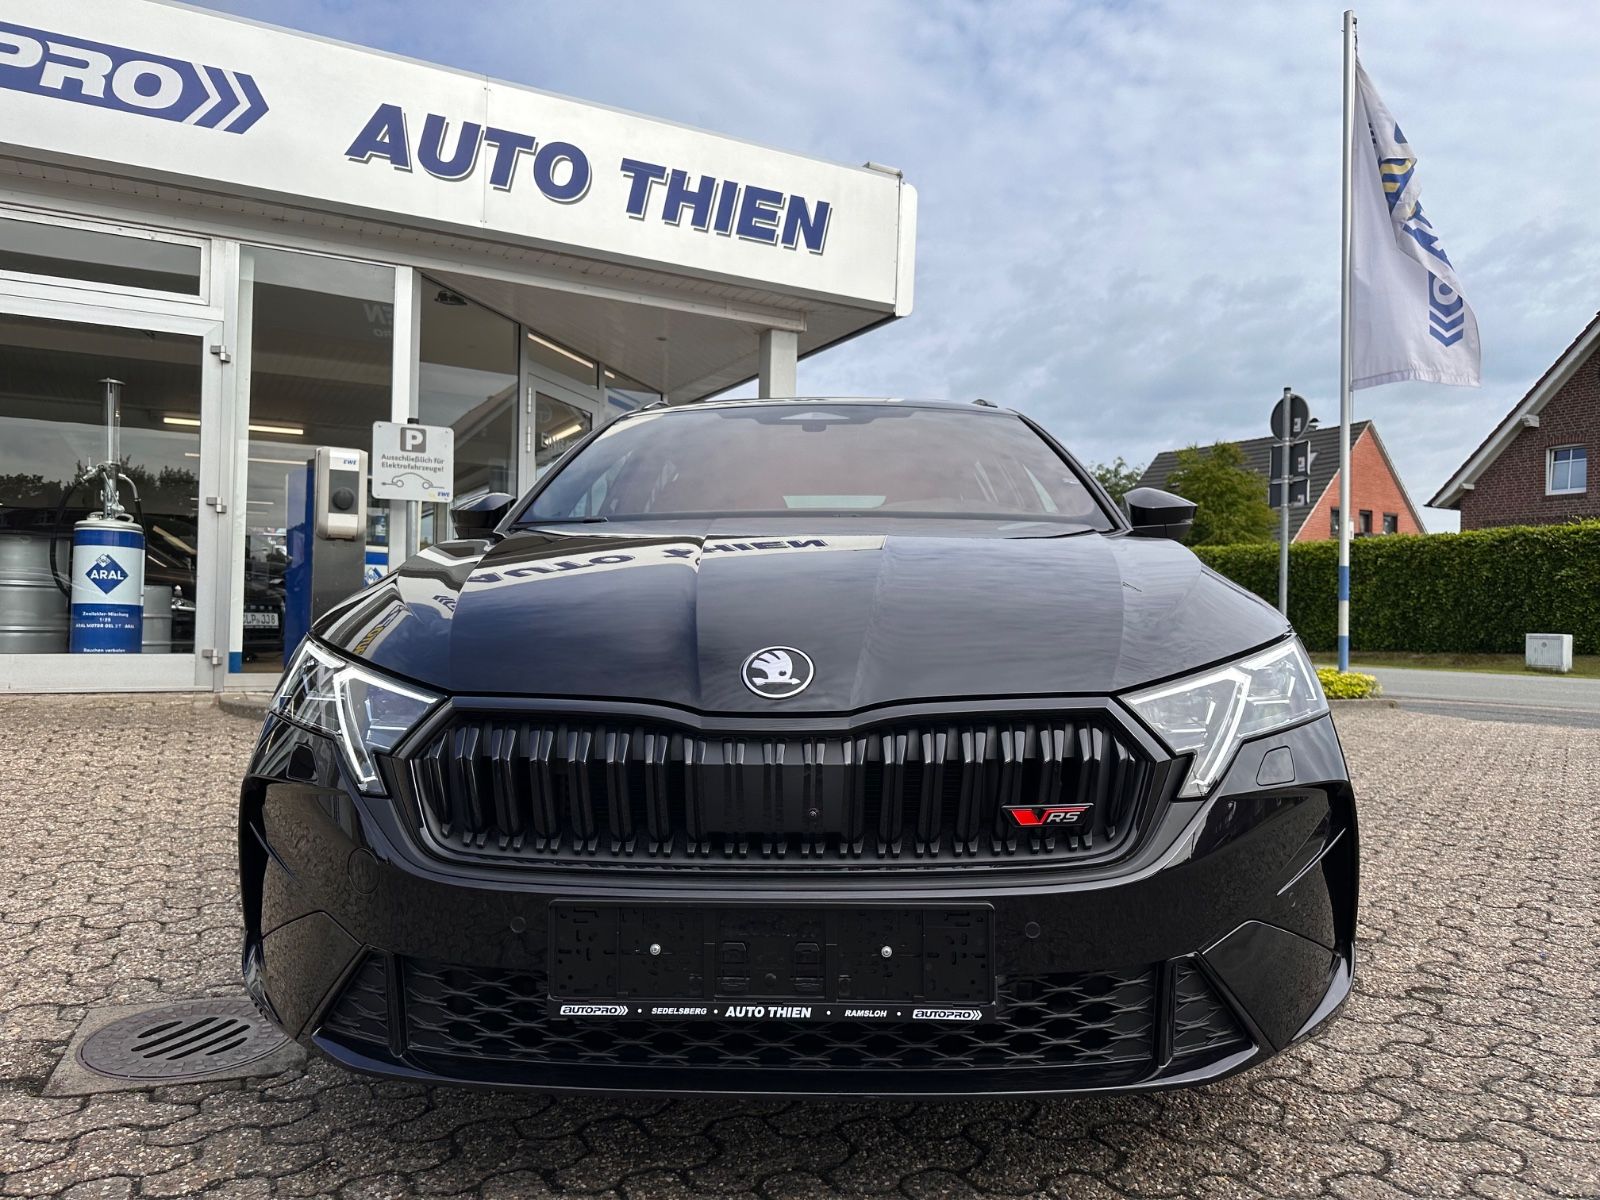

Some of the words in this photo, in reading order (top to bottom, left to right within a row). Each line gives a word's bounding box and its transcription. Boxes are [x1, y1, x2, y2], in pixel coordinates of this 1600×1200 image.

[344, 103, 591, 203] AUTO
[619, 157, 832, 255] THIEN
[405, 429, 424, 451] P
[381, 454, 433, 464] Ausschließlich
[433, 457, 445, 465] für
[90, 569, 125, 580] ARAL
[651, 1007, 708, 1015] SEDELSBERG
[725, 1006, 764, 1018] AUTO
[767, 1007, 812, 1019] THIEN
[844, 1009, 888, 1018] RAMSLOH
